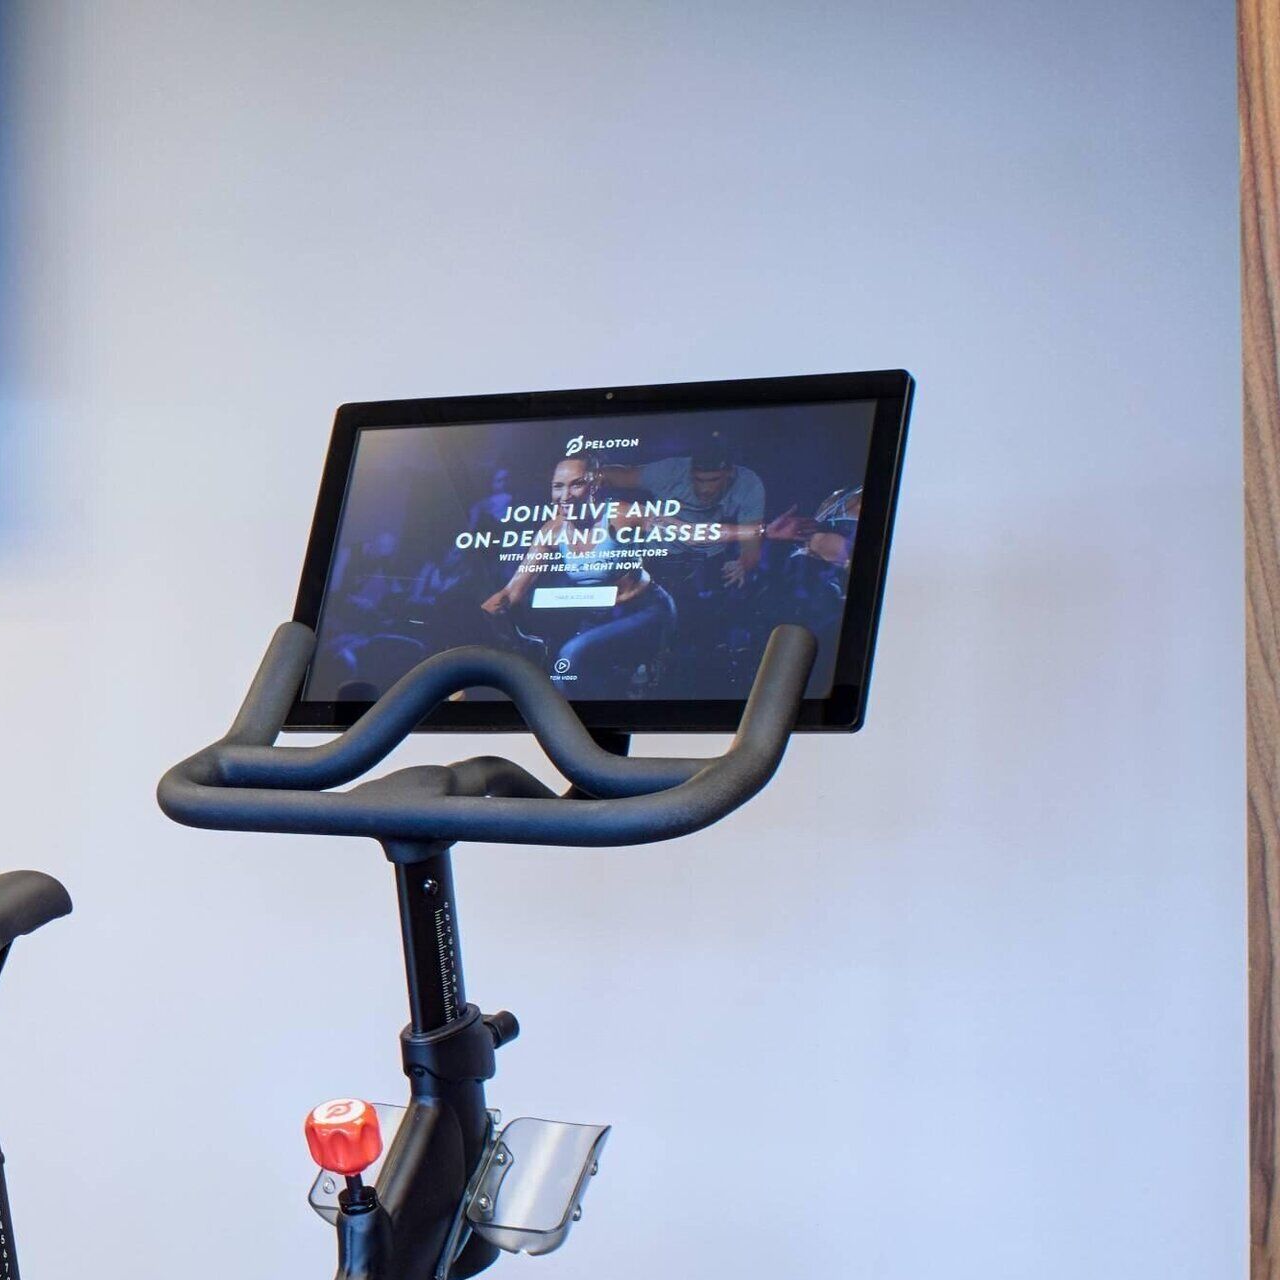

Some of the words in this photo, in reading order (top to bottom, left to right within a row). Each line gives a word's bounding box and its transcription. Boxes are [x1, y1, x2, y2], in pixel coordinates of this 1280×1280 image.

[584, 438, 640, 450] PELOTON
[501, 504, 559, 523] JOIN
[566, 501, 620, 521] LIVE
[626, 499, 681, 519] AND
[455, 527, 610, 550] ON-DEMAND
[616, 522, 722, 545] CLASSES
[499, 553, 524, 562] WITH
[526, 550, 597, 561] WORLD-CLASS
[599, 547, 669, 559] INSTRUCTORS
[518, 564, 549, 574] RIGHT
[581, 562, 613, 572] RIGHT
[615, 561, 644, 571] NOW.
